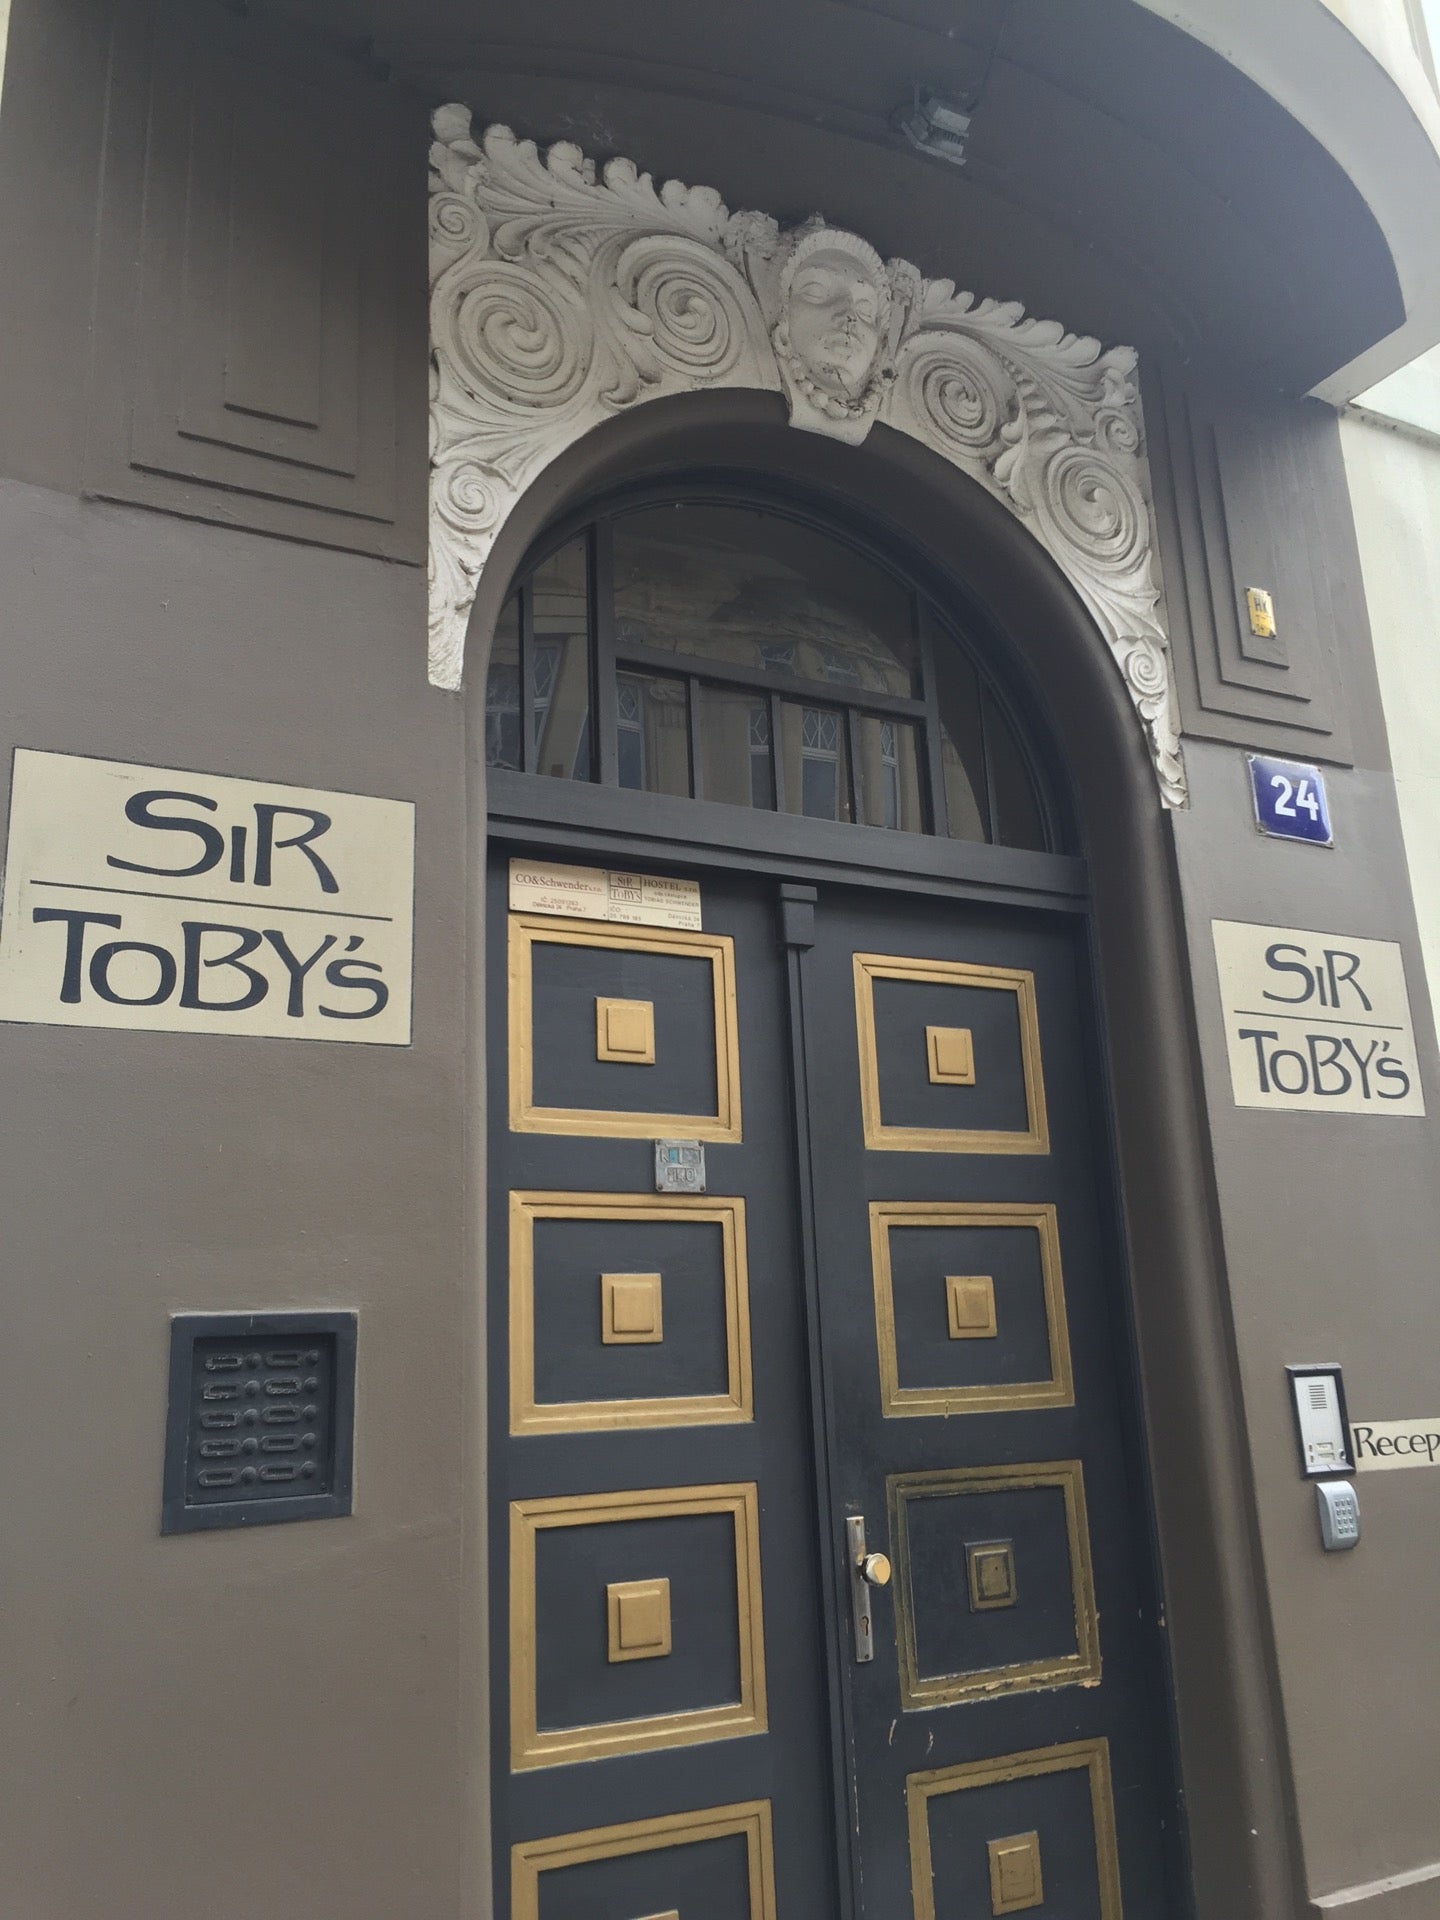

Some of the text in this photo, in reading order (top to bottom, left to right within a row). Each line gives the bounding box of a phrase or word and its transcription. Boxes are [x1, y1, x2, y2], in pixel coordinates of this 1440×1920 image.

[1270, 775, 1319, 821] 24
[106, 790, 340, 893] SIR
[643, 879, 682, 892] HOSTEL
[1262, 943, 1373, 1012] SIR
[1353, 1426, 1440, 1462] Recep
